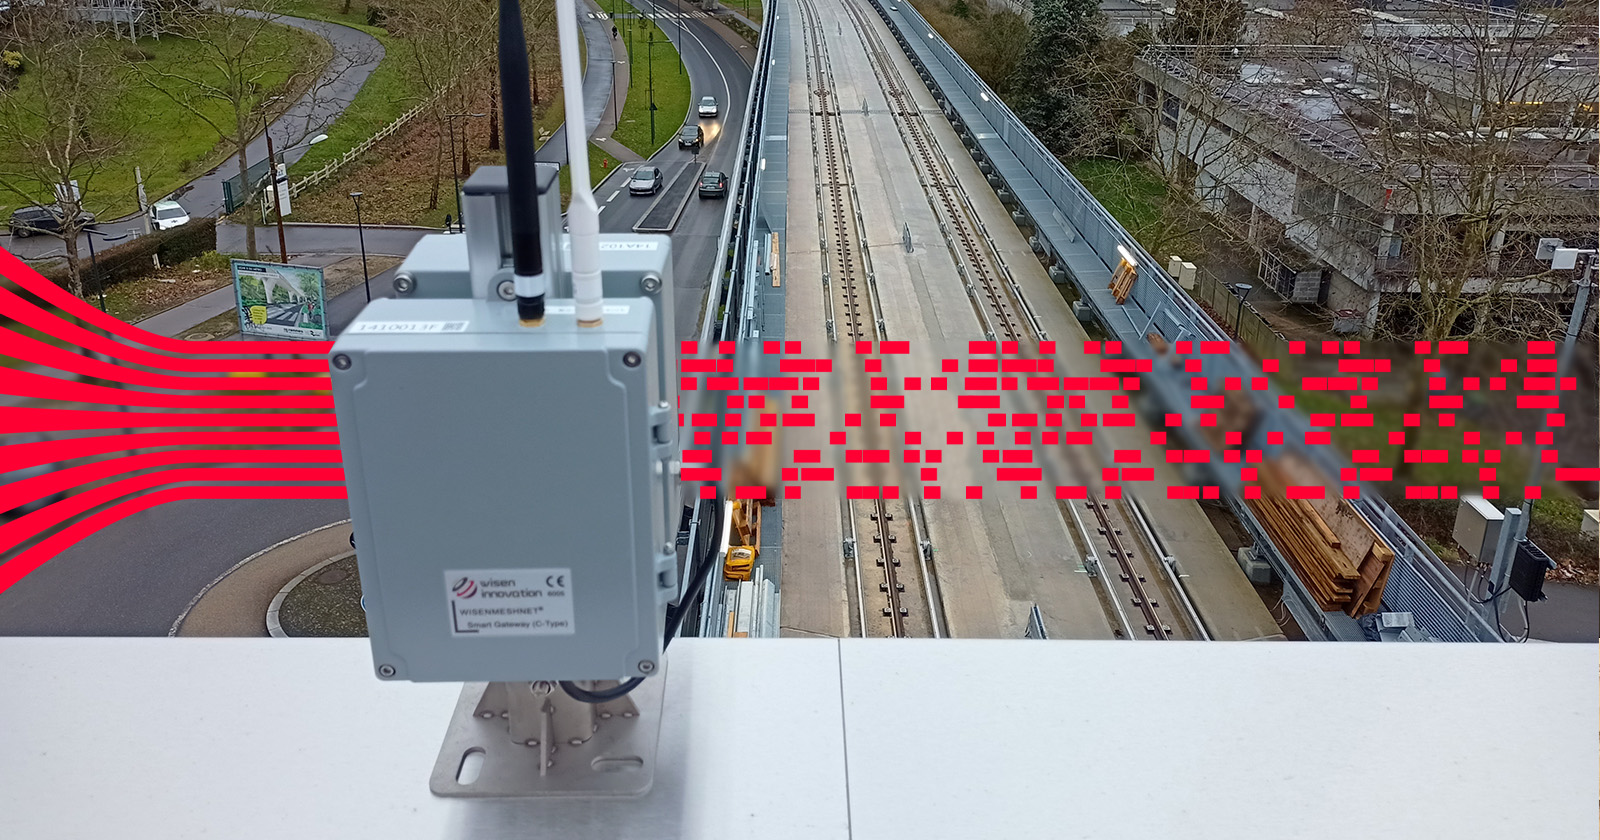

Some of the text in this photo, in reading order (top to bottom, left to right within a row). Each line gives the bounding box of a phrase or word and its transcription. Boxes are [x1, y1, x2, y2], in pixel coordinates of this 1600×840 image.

[480, 579, 516, 587] wisen
[481, 588, 543, 598] innovation
[467, 619, 569, 629] Smart Gateway (C-Type)
